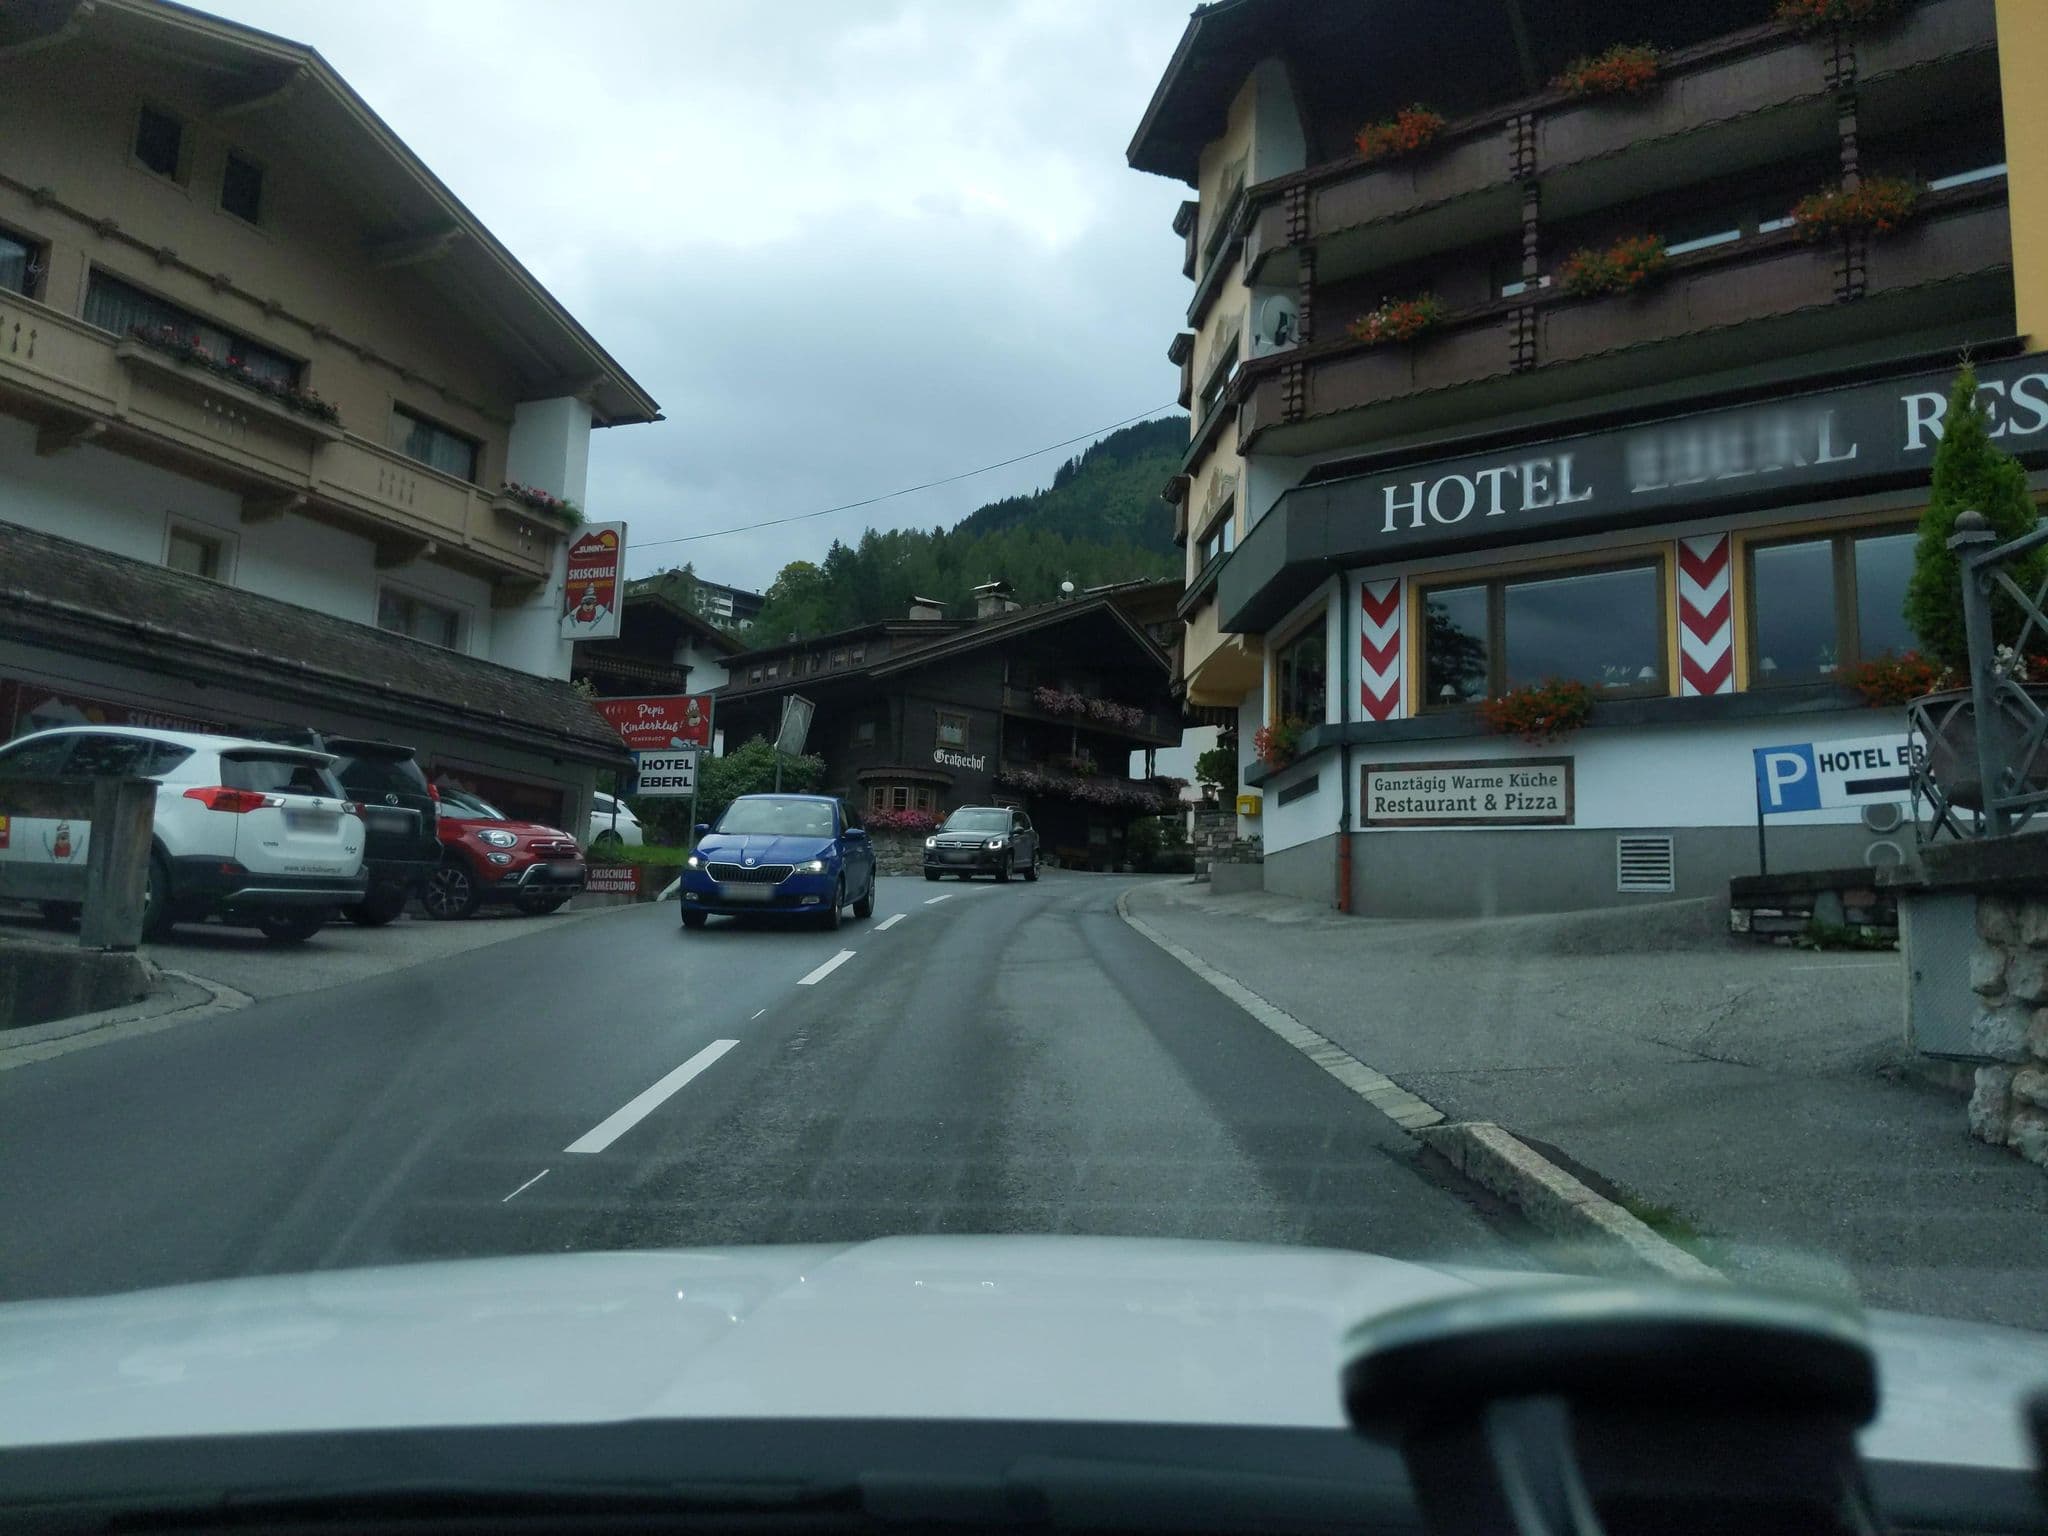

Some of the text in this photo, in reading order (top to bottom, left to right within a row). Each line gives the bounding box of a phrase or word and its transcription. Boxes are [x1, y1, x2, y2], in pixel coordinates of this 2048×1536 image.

[1380, 453, 1593, 532] HOTEL
[568, 566, 616, 580] SKISCHULE
[637, 703, 664, 718] Pepis
[641, 759, 693, 770] HOTEL
[1819, 748, 1891, 773] HOTEL
[640, 776, 692, 787] EBERL
[1374, 772, 1558, 793] Ganztägig Warme Küche
[1765, 752, 1808, 806] P
[1374, 793, 1558, 813] Restaurant & Pizza
[592, 868, 633, 879] SKISCHULE
[585, 880, 636, 891] ANMELDUNG
